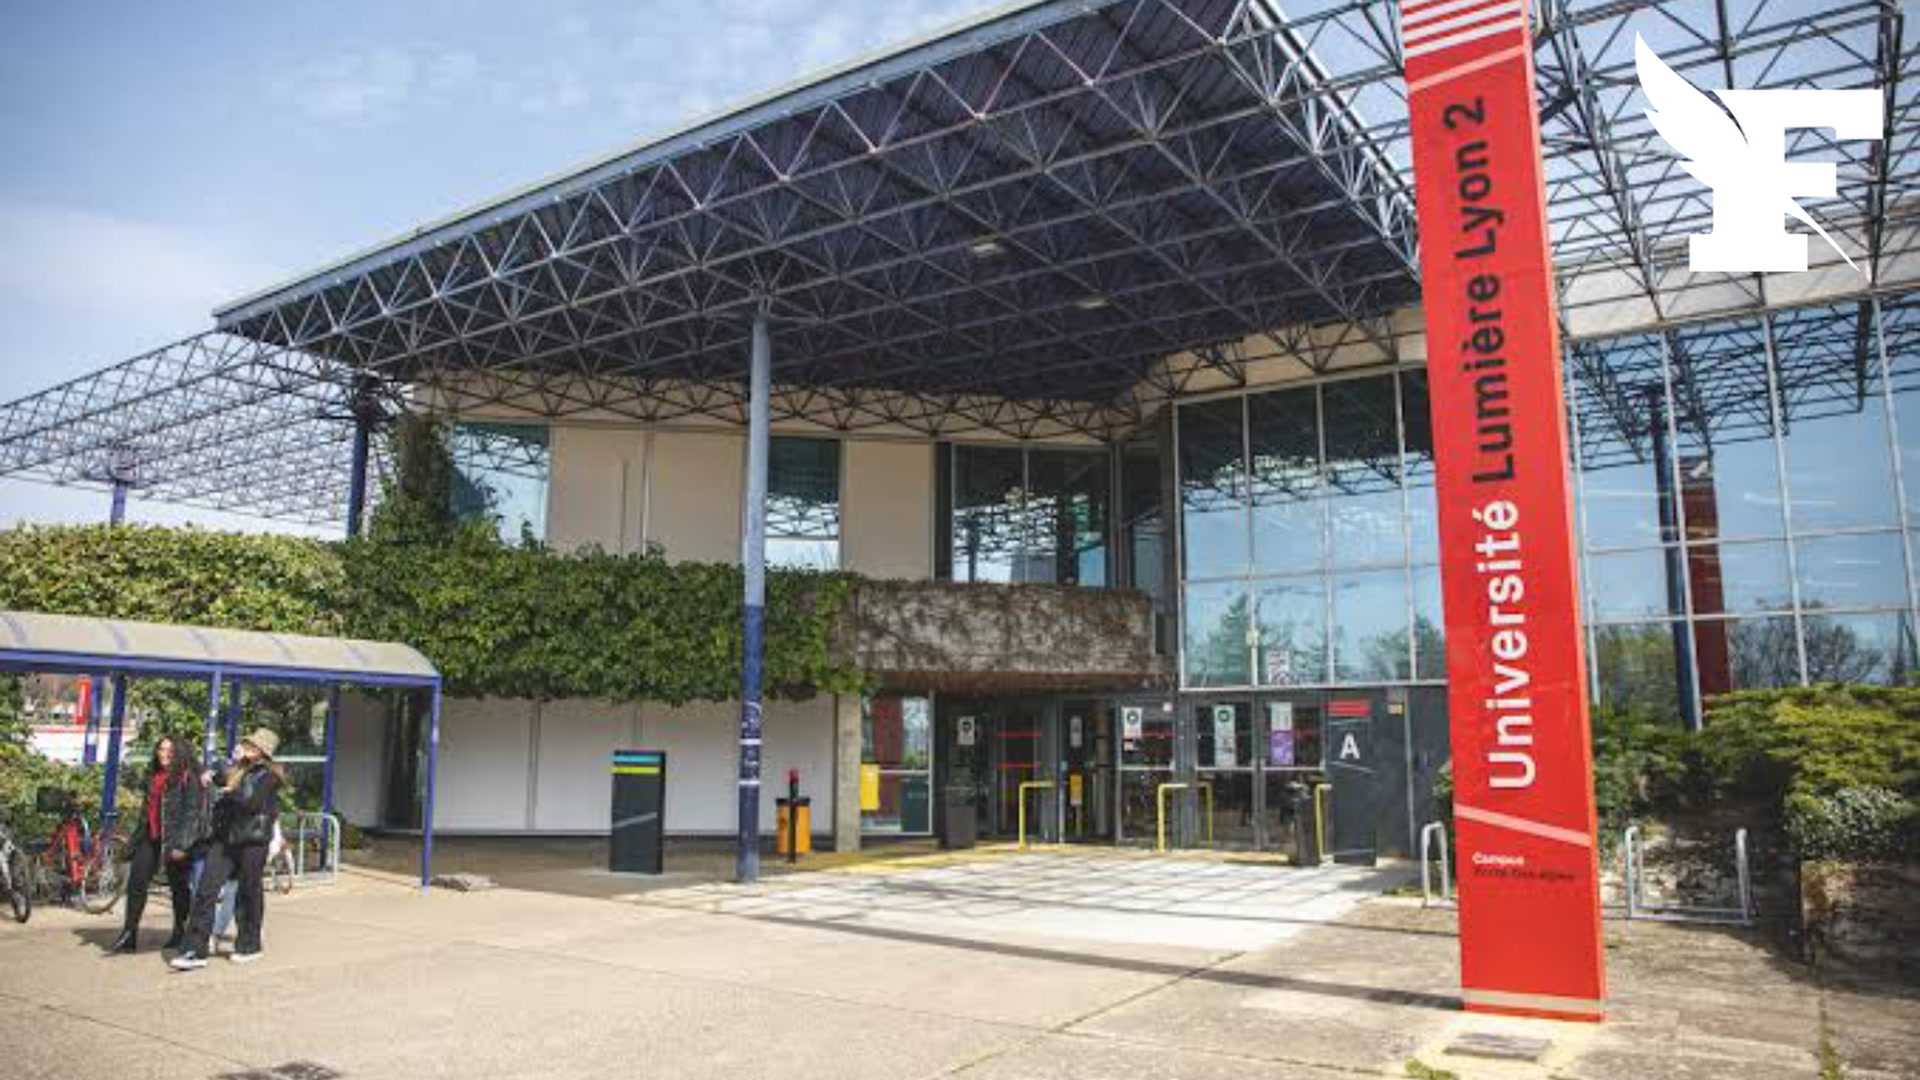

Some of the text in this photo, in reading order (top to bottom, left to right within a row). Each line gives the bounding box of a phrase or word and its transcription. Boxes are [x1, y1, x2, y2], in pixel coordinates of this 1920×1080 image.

[1442, 97, 1536, 788] Université Lumière Lyon 2
[1340, 733, 1360, 759] A
